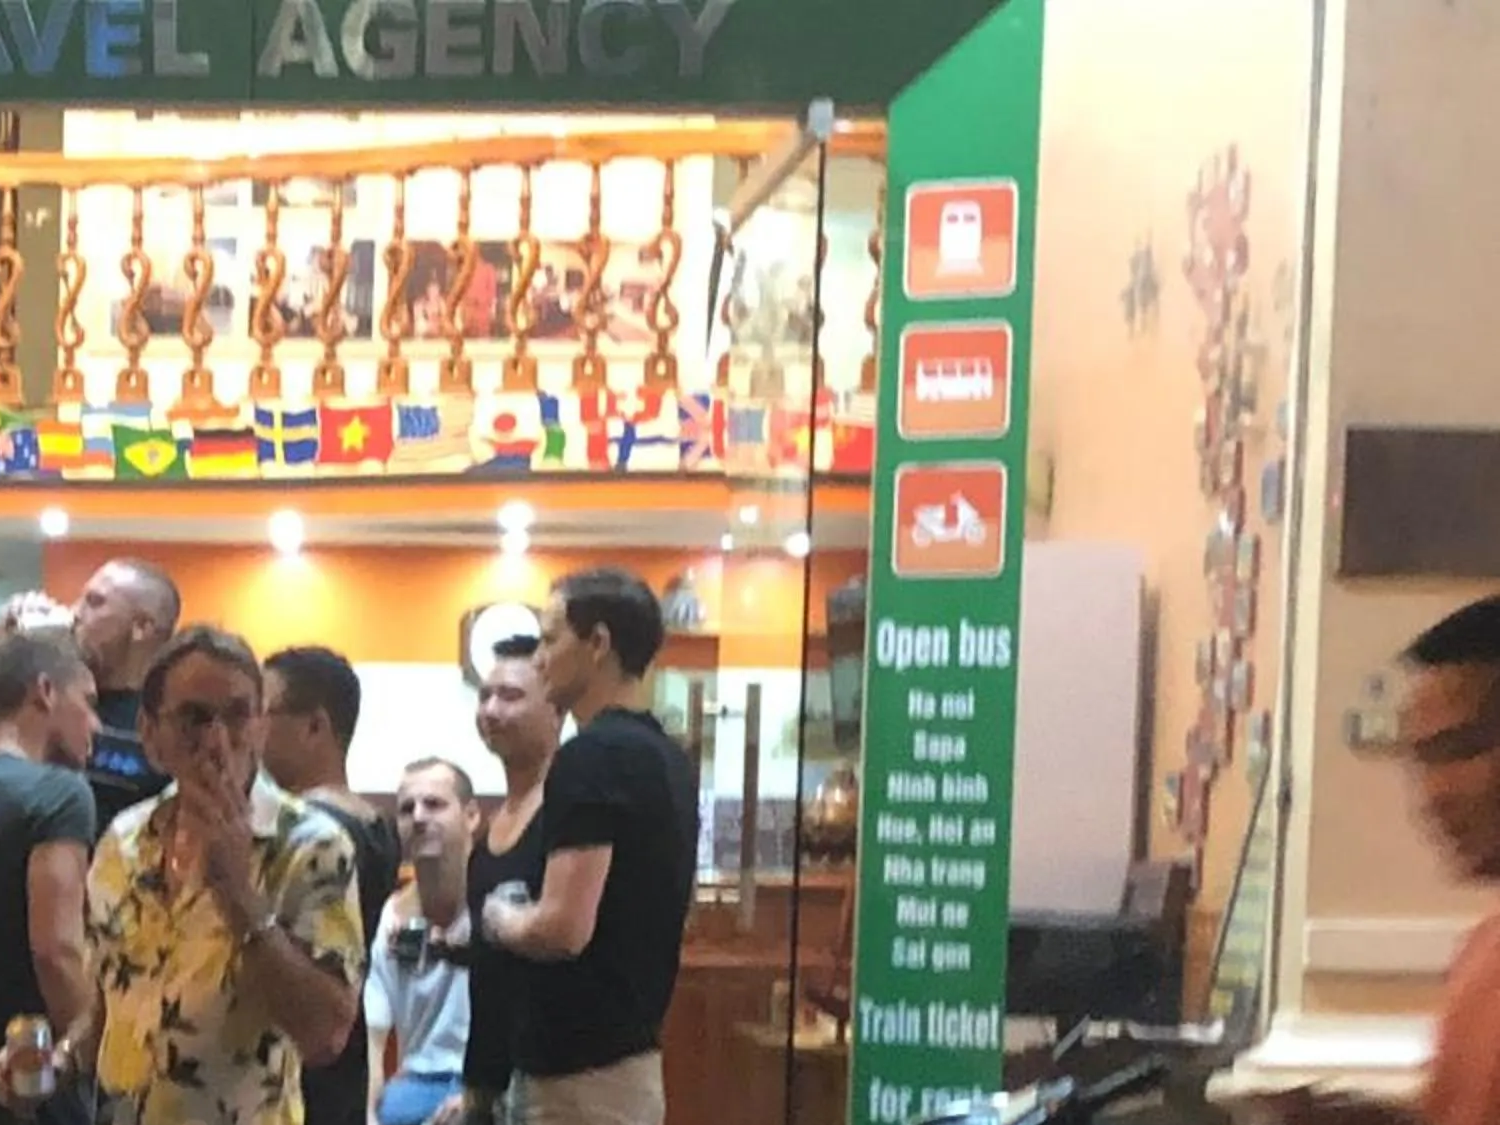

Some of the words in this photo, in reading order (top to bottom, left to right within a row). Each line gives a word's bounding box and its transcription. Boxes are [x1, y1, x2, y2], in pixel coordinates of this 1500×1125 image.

[257, 0, 736, 79] AGENCY
[876, 618, 950, 673] Open
[959, 618, 1011, 669] bus
[908, 687, 936, 720] Ha
[941, 686, 975, 720] noi
[914, 729, 967, 766] Sapa
[887, 770, 936, 804] Ninh
[942, 771, 989, 804] binh
[883, 854, 925, 887] Nha
[897, 894, 937, 929] Mui
[859, 995, 921, 1043] Train
[927, 1001, 999, 1049] ticket
[870, 1077, 912, 1124] for
